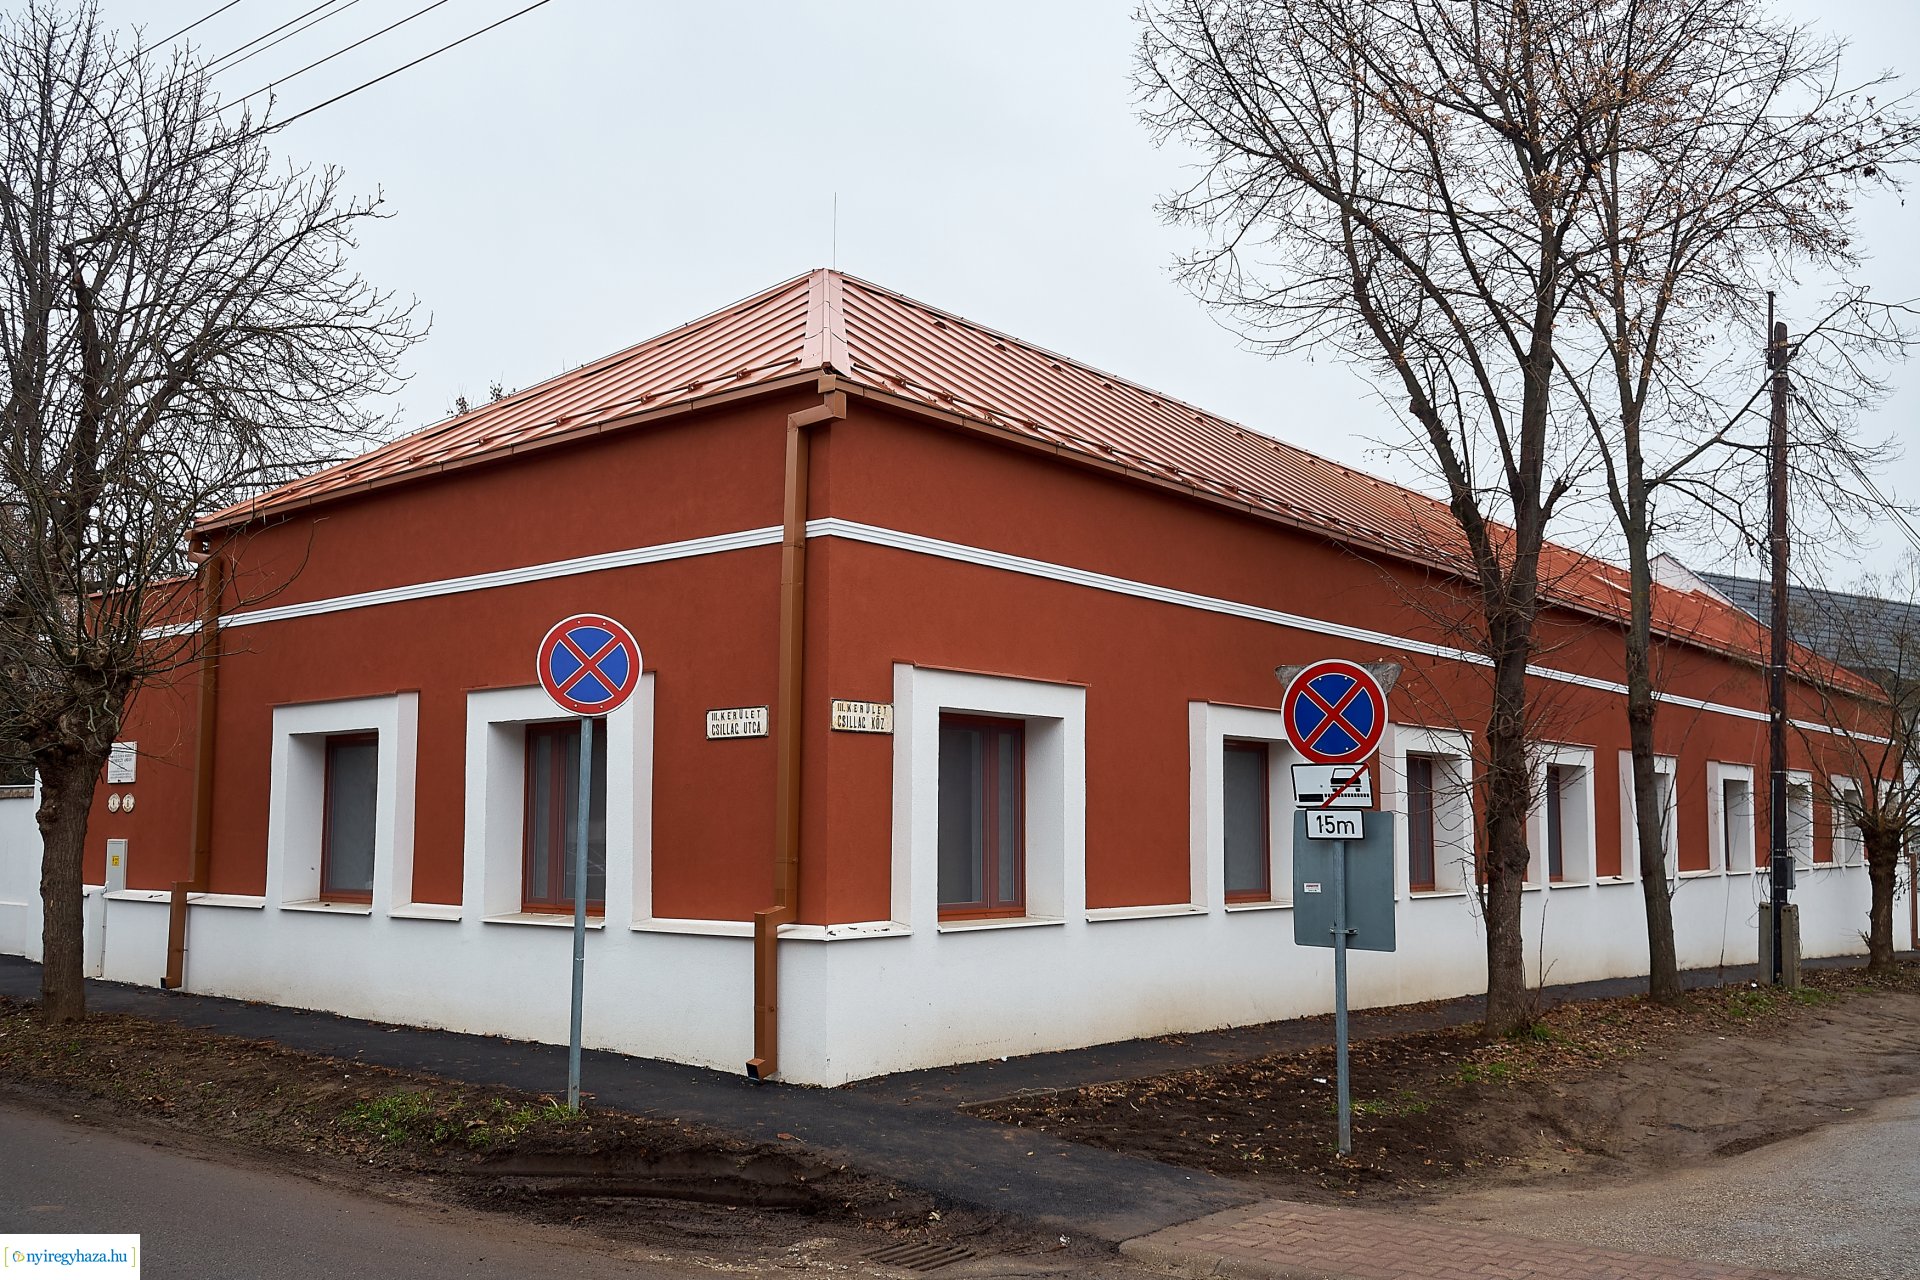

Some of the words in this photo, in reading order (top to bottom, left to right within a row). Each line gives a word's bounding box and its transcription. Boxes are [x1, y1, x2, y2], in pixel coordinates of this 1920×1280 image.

[711, 722, 739, 736] CSILLAG
[743, 721, 761, 734] UTCA
[837, 715, 866, 729] CSILLAG
[871, 715, 885, 730] KÖZ
[1316, 814, 1355, 835] 15m
